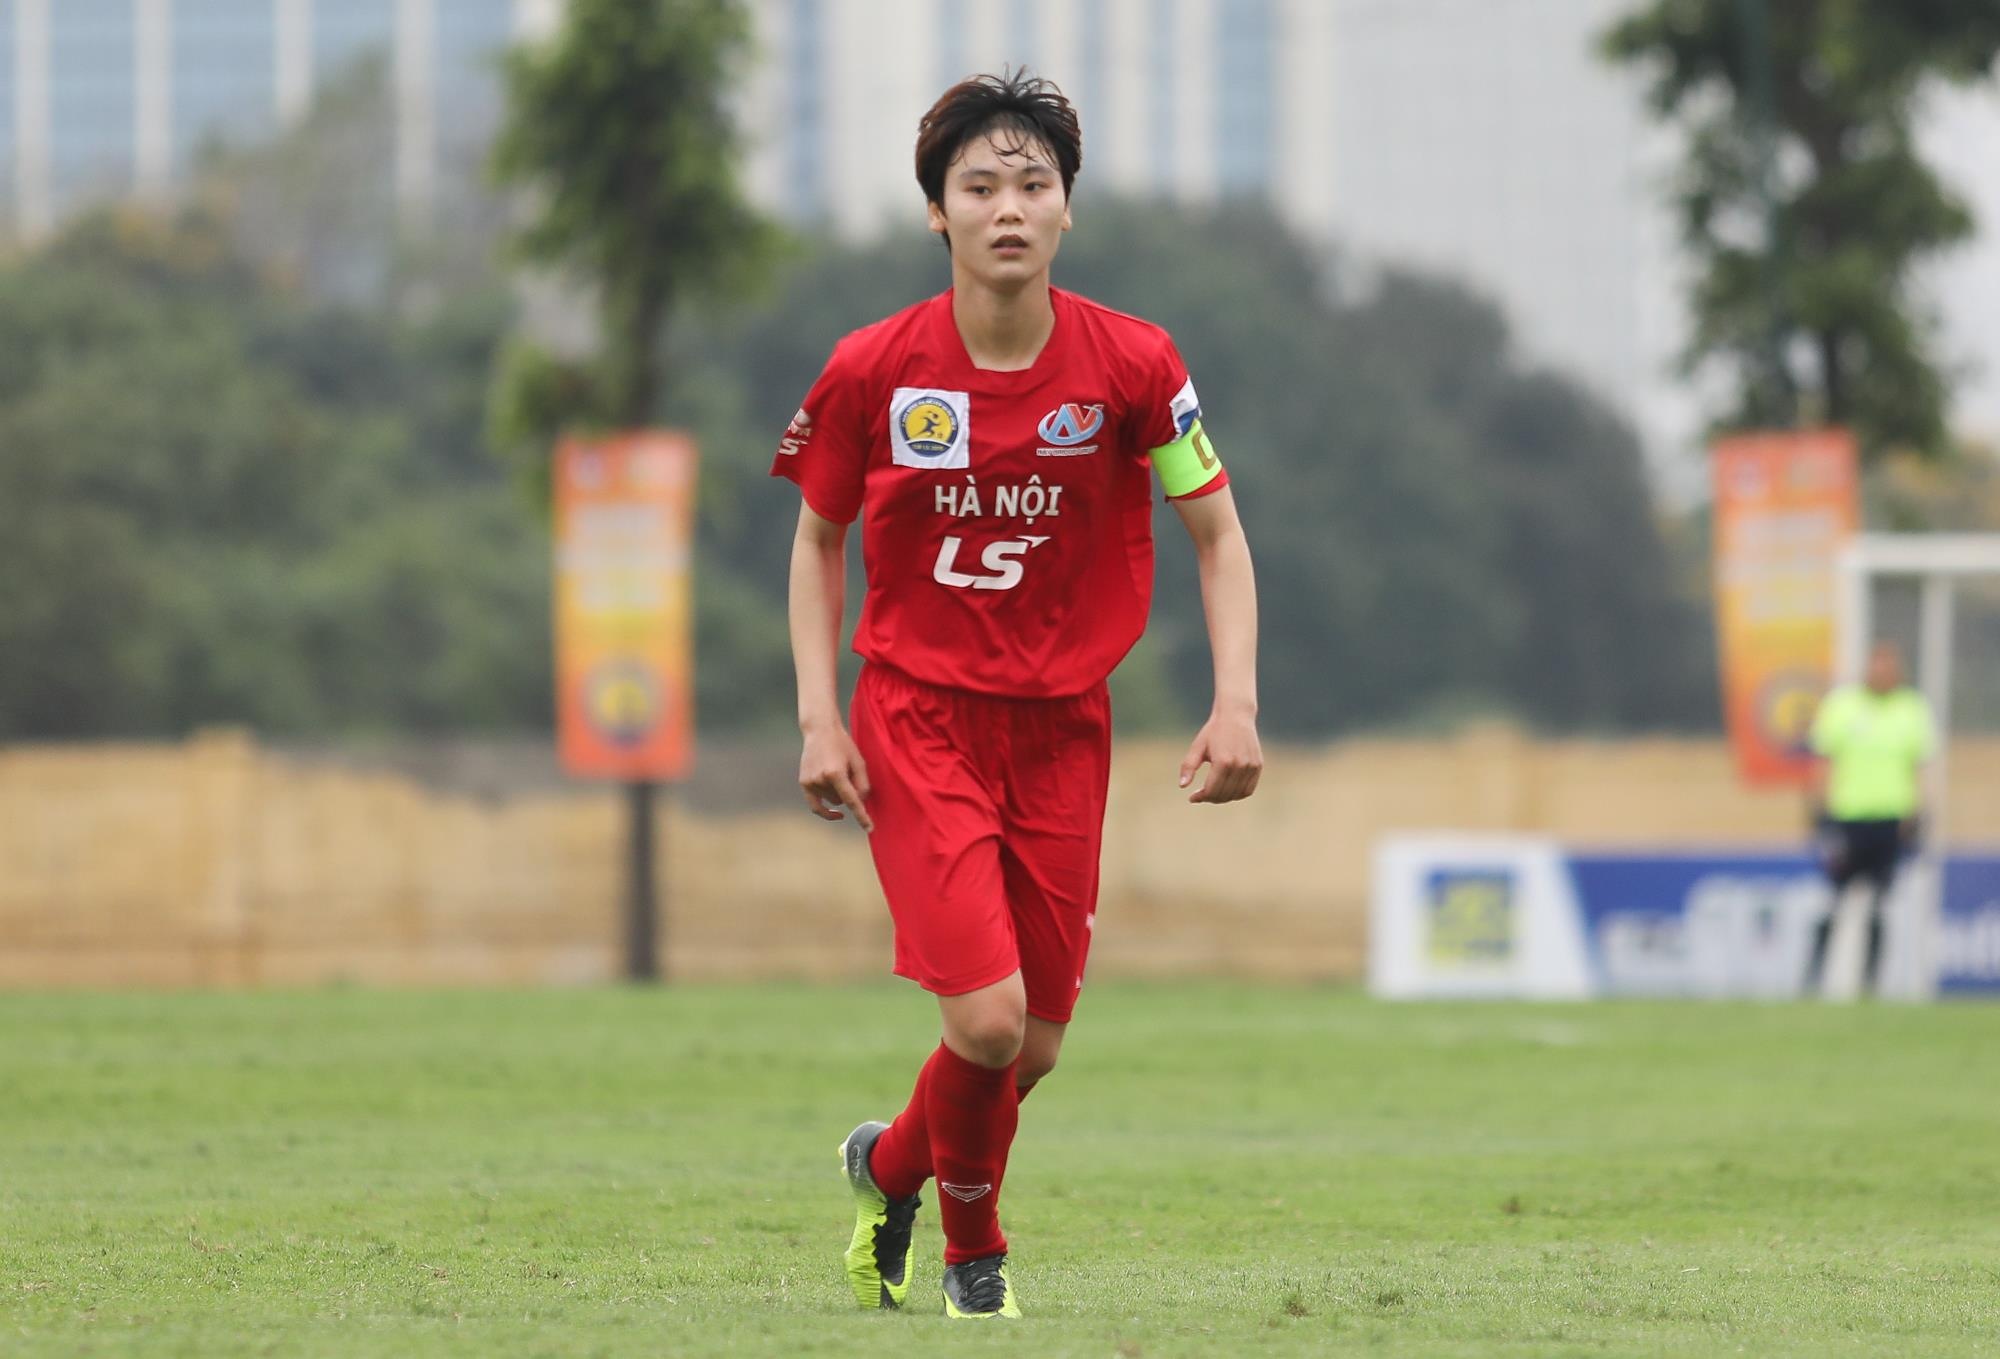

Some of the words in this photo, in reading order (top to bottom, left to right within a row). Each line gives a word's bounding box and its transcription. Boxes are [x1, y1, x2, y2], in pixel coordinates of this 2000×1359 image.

[934, 474, 983, 518] HÀ
[994, 474, 1063, 525] NỘI
[932, 535, 1032, 591] LS
